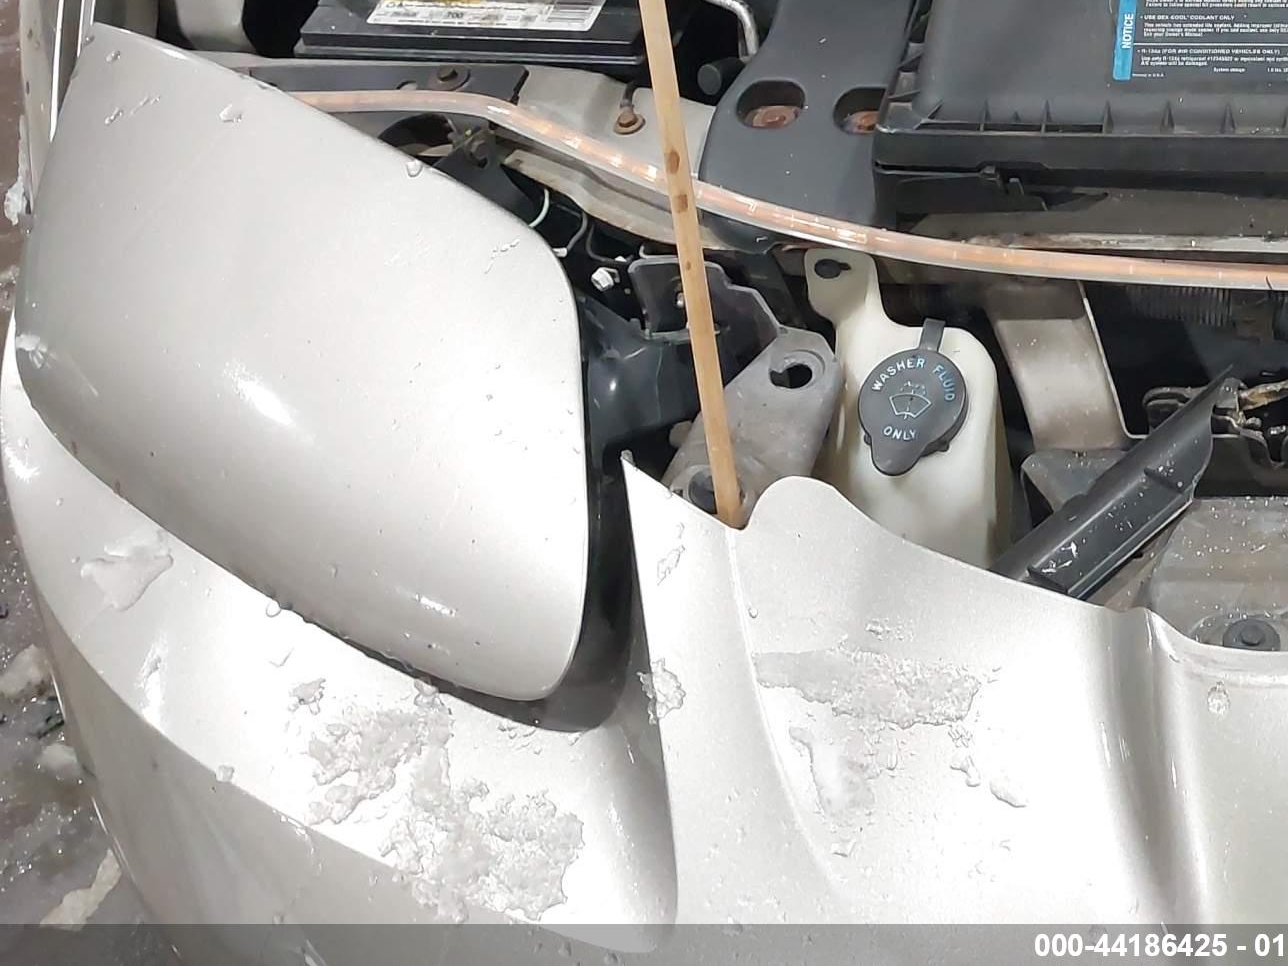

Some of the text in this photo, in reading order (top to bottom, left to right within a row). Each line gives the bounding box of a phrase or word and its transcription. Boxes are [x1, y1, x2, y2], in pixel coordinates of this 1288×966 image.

[1122, 14, 1134, 48] NOTICE
[872, 358, 956, 401] WASHER FLUID
[884, 426, 916, 440] ONLY
